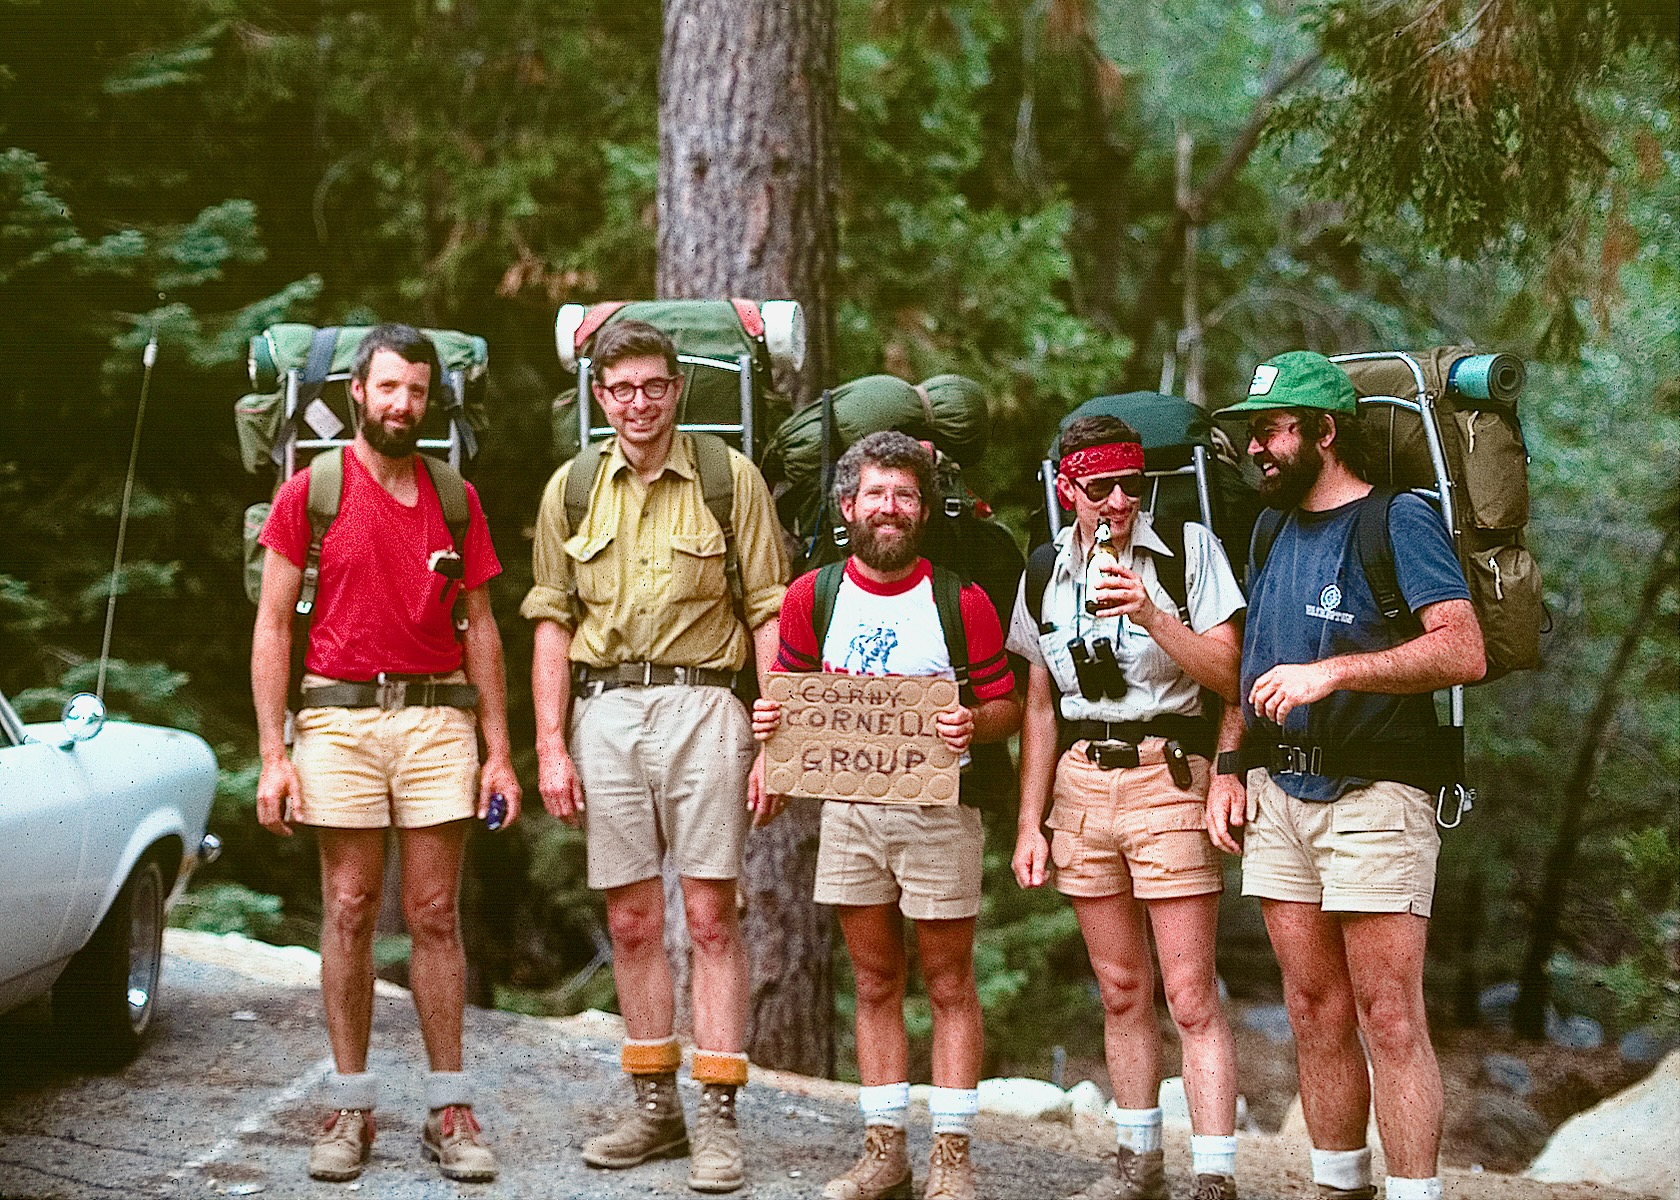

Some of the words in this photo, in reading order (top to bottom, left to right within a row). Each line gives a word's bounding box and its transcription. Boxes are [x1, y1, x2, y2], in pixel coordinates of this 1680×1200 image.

[802, 685, 901, 707] CORNY
[786, 709, 933, 737] CORNELL
[801, 748, 925, 774] GROUP
